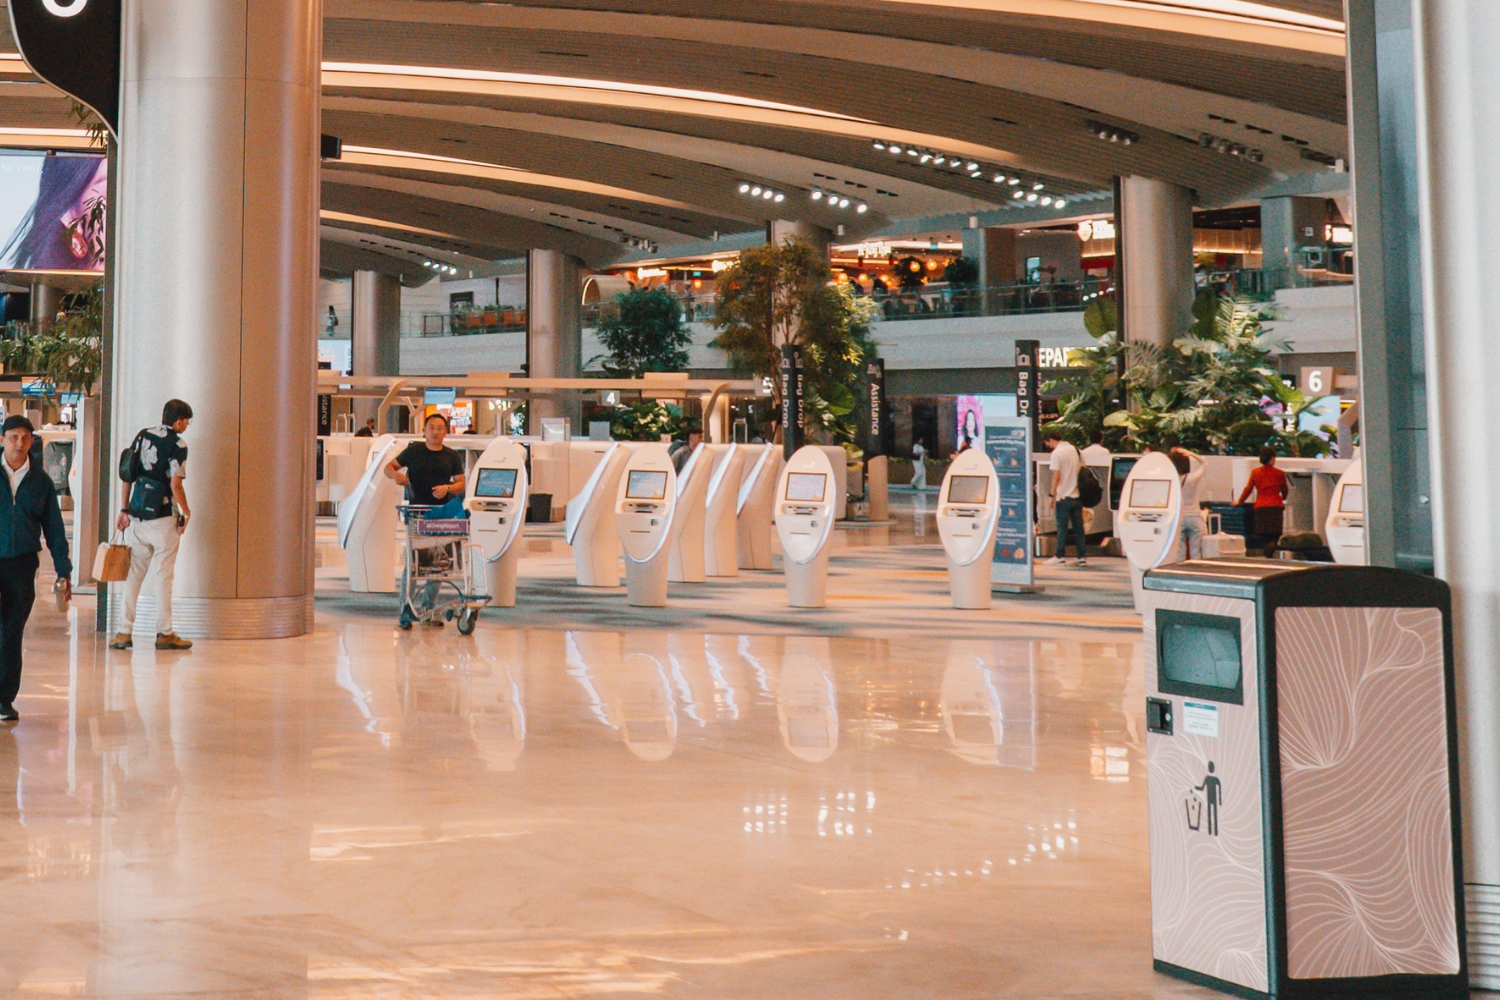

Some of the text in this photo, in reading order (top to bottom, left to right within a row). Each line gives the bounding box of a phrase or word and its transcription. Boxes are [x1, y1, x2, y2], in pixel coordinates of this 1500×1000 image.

[1017, 371, 1029, 417] Bag Dr
[1309, 370, 1322, 392] 6
[321, 396, 330, 426] istance
[606, 392, 616, 405] 4
[782, 398, 790, 428] Drop
[870, 383, 881, 436] Assistance
